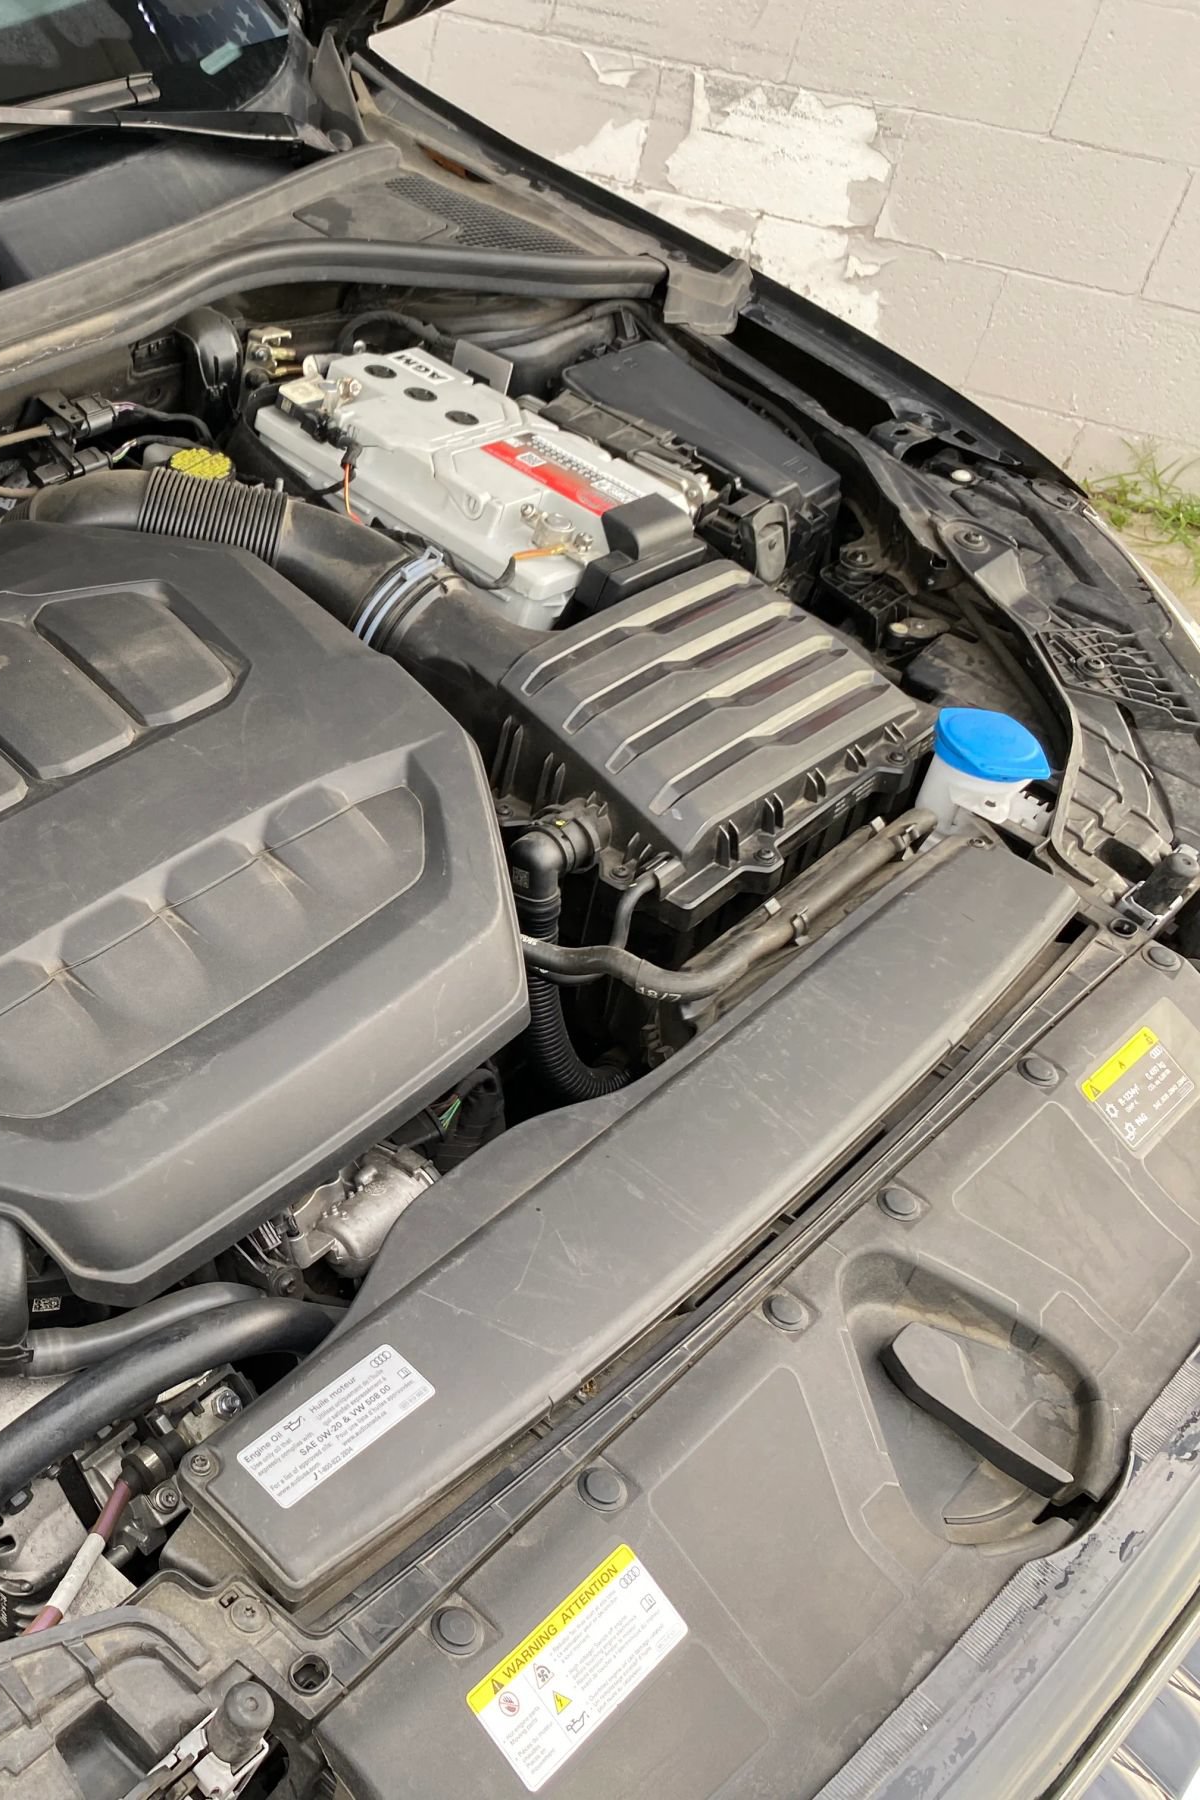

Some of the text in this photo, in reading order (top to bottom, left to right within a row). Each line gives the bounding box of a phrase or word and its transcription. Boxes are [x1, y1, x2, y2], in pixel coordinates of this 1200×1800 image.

[392, 354, 448, 380] AGM
[307, 1376, 358, 1414] Huile moteur
[298, 1439, 318, 1456] SAE
[315, 1420, 343, 1443] 0W-20
[341, 1414, 351, 1423] &
[349, 1402, 366, 1417] VW
[363, 1391, 381, 1406] 508
[378, 1383, 391, 1395] 00
[242, 1430, 284, 1464] Engine Oil
[502, 1622, 558, 1681] WARNING
[558, 1562, 618, 1624] ATTENTION
